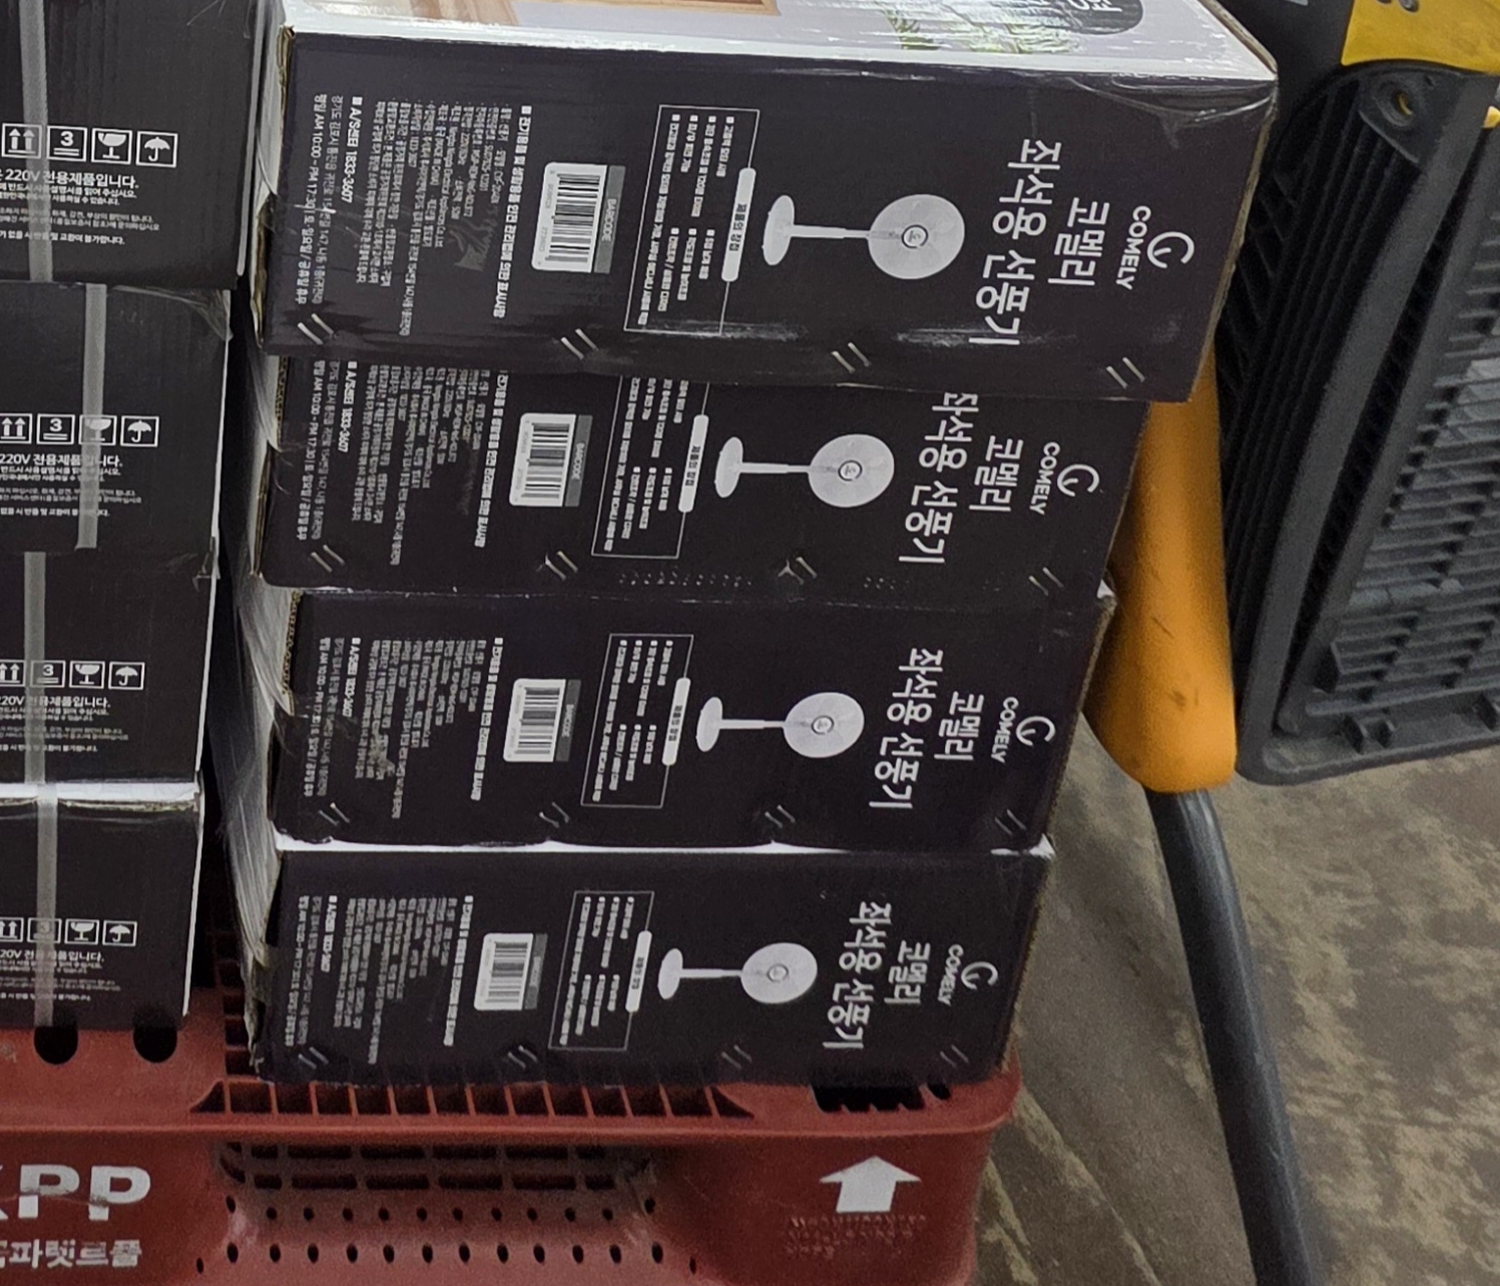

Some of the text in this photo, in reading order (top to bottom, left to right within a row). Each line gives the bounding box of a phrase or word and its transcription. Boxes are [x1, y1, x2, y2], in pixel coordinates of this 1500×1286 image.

[310, 132, 323, 158] 10:00
[313, 114, 325, 129] AM
[341, 107, 362, 203] A/S센터 1833-3607
[5, 169, 41, 182] 220V
[307, 166, 320, 181] PM
[966, 138, 1063, 348] 좌석용 선풍기
[1047, 199, 1112, 291] 코멜리
[1115, 204, 1153, 291] COMELY
[337, 408, 352, 453] 1833-3607
[969, 435, 1023, 515] 코멜리
[1029, 440, 1060, 516] COMELY
[898, 478, 954, 568] 선풍기
[868, 645, 945, 812] 좌석용 선풍기
[935, 690, 986, 763] 코멜리
[991, 695, 1019, 765] COMELY
[821, 900, 893, 1052] 좌석용 선풍기
[883, 938, 932, 1007] 코멜리
[936, 943, 965, 1007] COMELY
